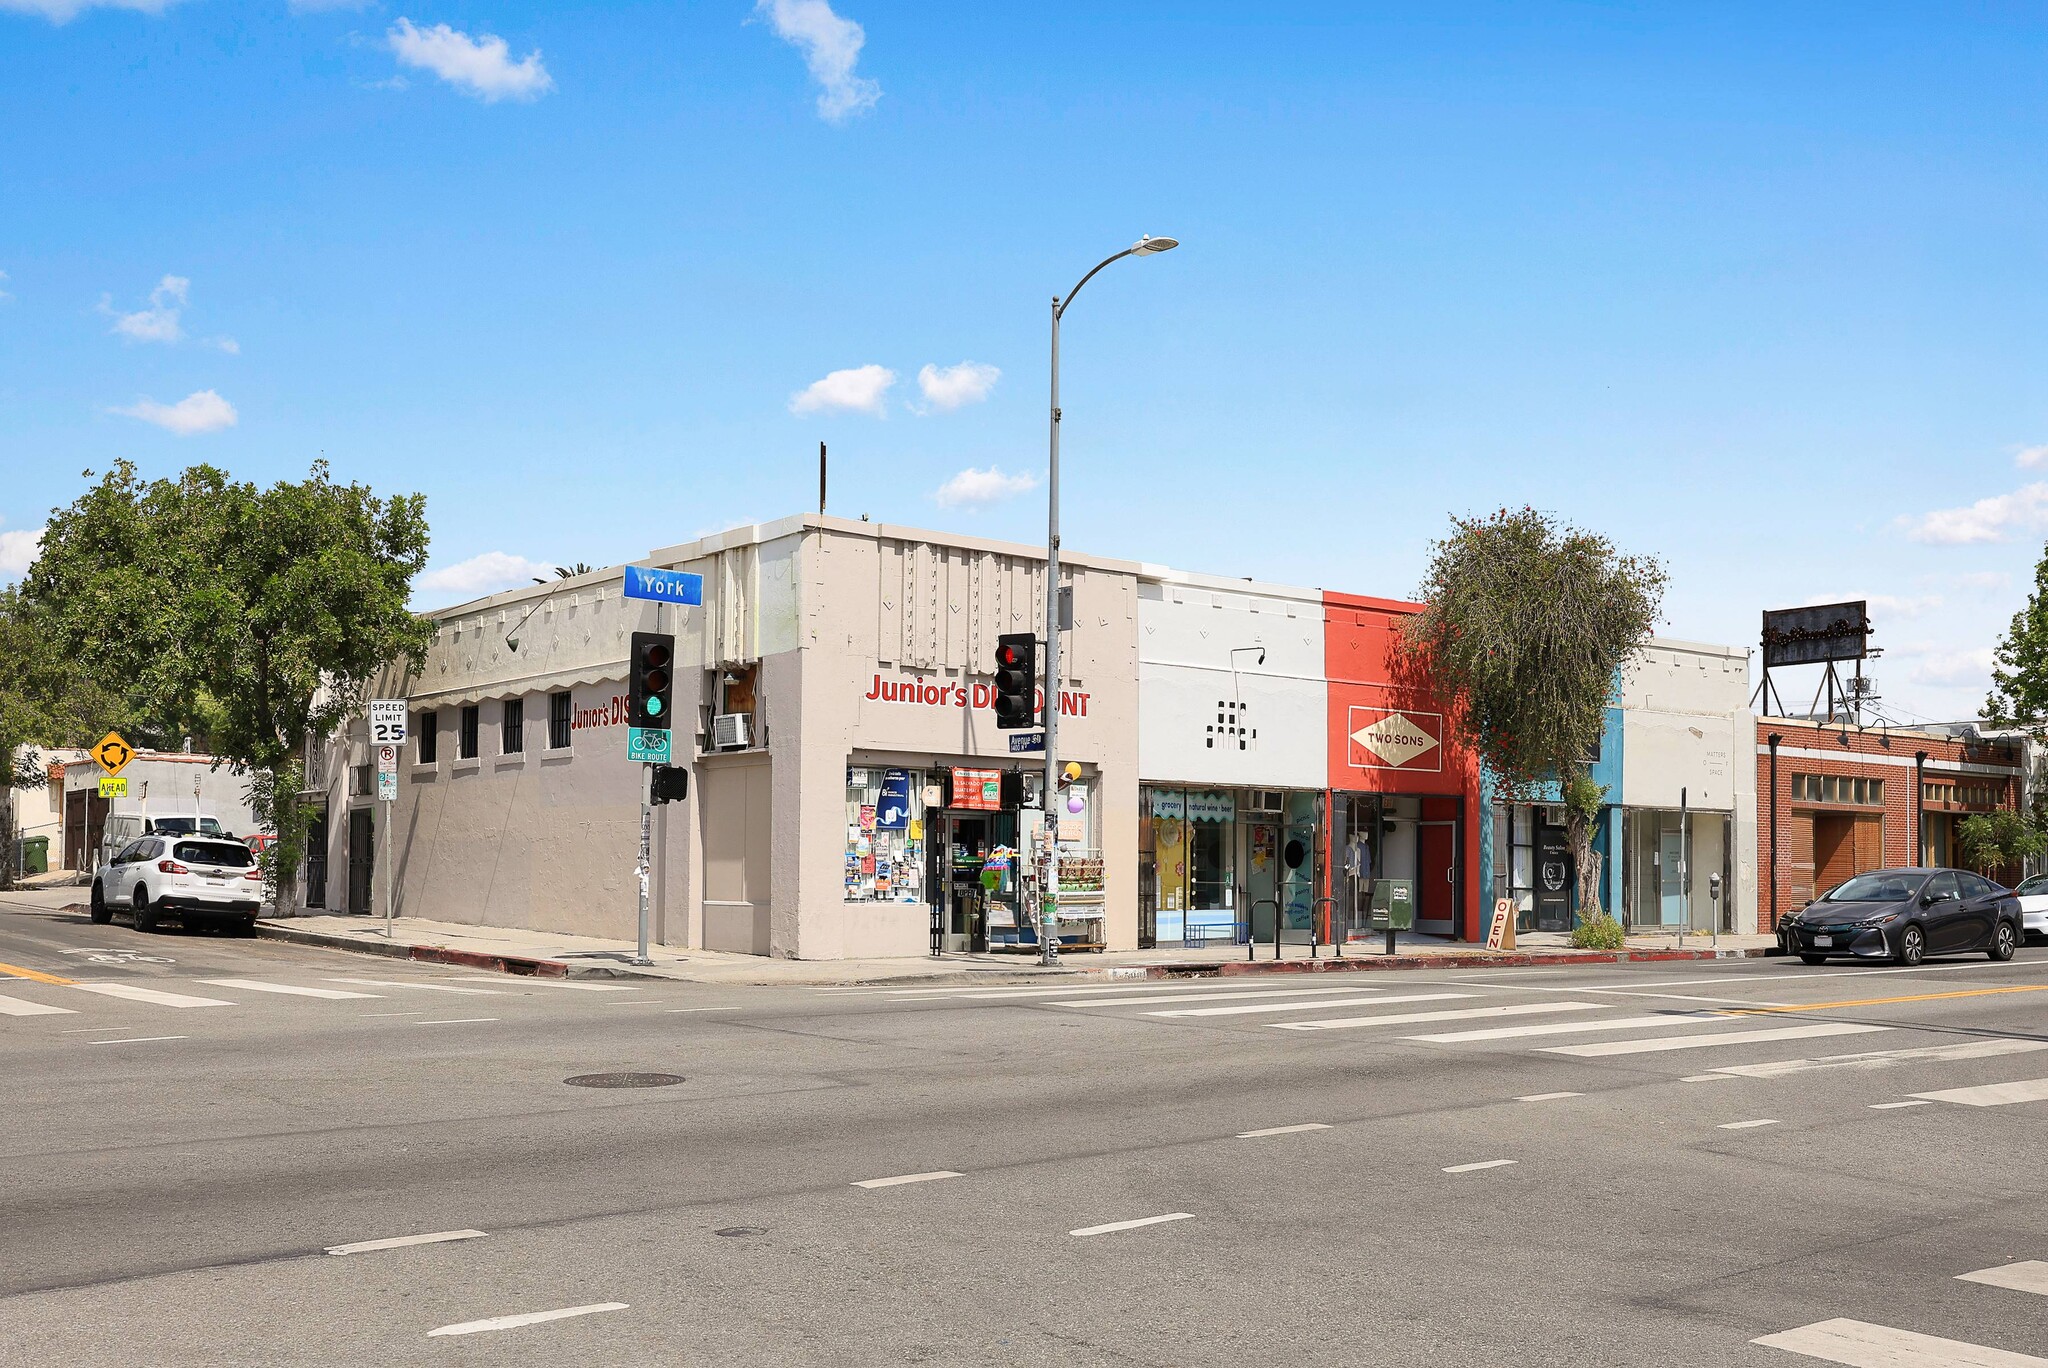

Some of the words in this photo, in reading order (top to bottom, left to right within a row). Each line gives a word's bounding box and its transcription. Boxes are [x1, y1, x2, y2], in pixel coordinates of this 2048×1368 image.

[643, 575, 684, 597] York
[866, 674, 968, 708] Junior's
[372, 703, 404, 711] SPEED
[571, 702, 609, 730] Junior's
[374, 724, 404, 740] 25
[1011, 736, 1031, 746] Avenue
[1368, 732, 1392, 744] TWO
[1394, 734, 1424, 747] SONS
[631, 752, 645, 760] BIKE
[647, 753, 667, 761] ROUTE
[101, 783, 125, 792] AHEAD
[1161, 802, 1182, 811] grocery
[1207, 804, 1218, 812] wine
[1221, 804, 1232, 813] beer
[1489, 901, 1507, 949] OPEN
